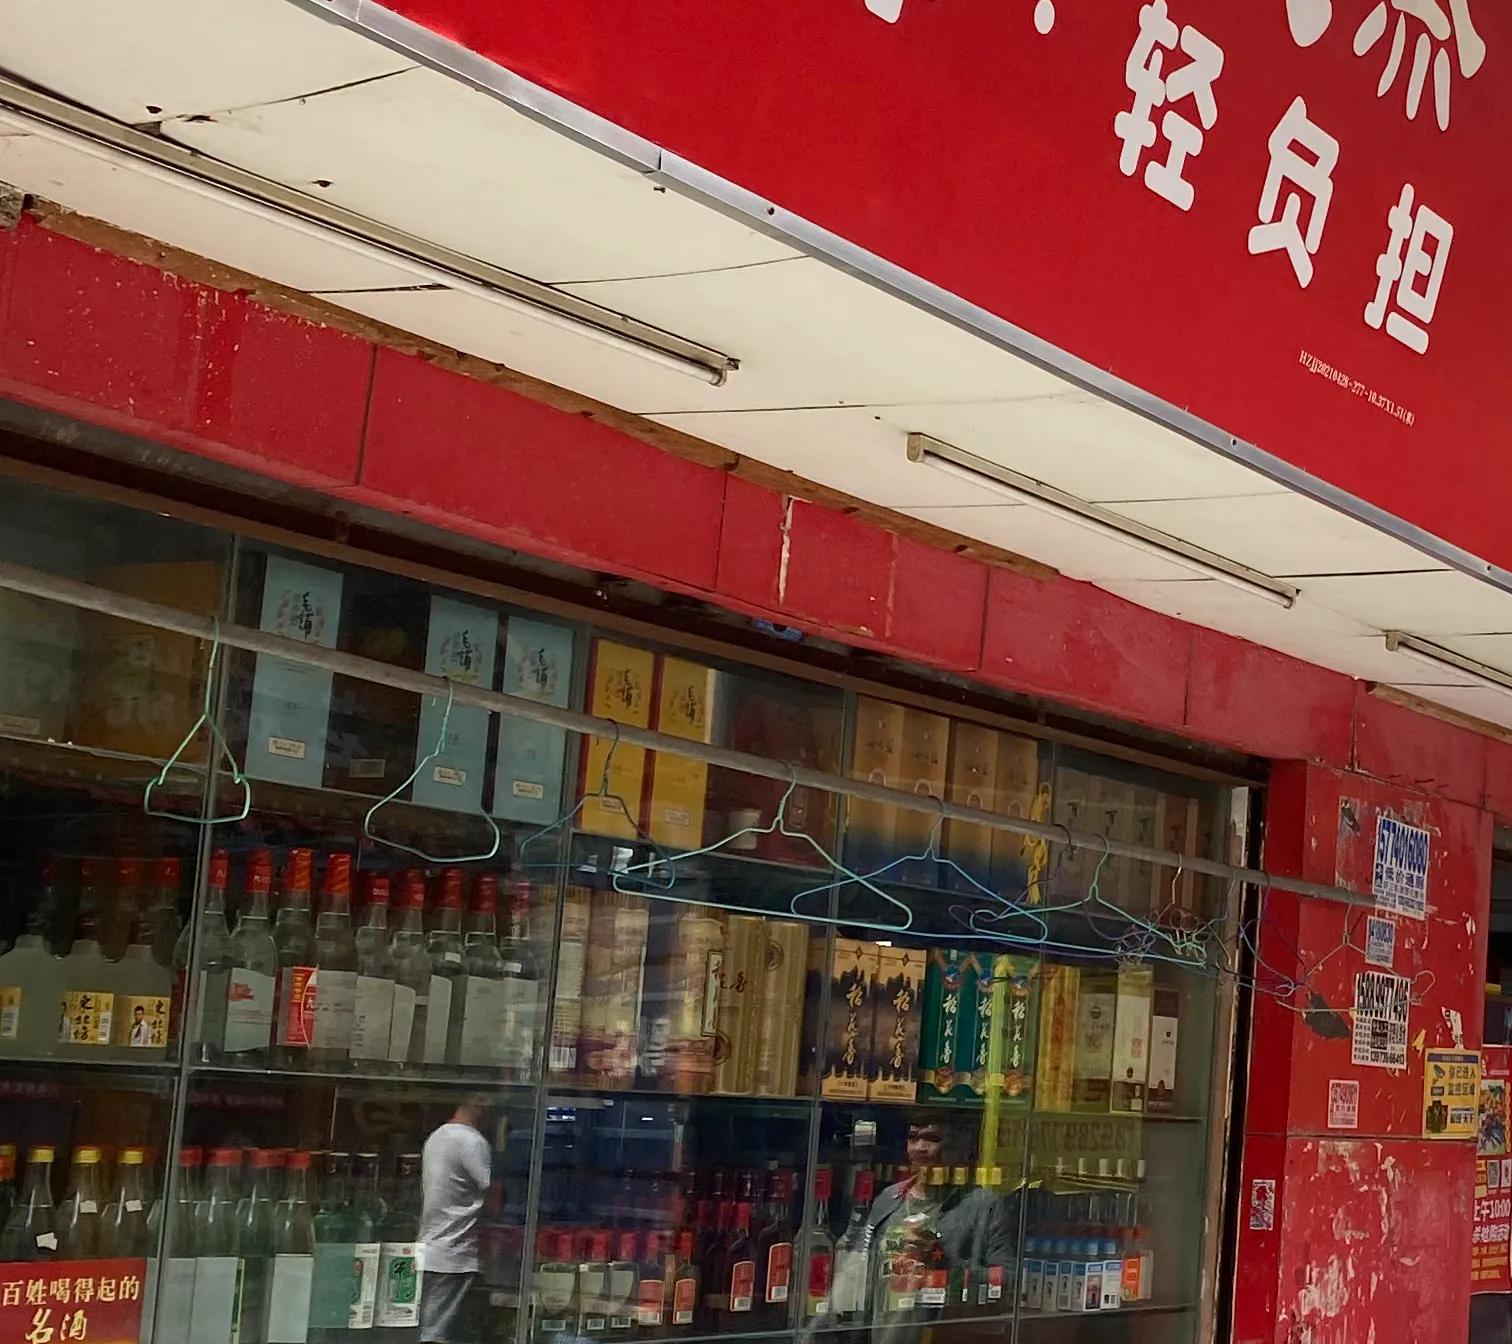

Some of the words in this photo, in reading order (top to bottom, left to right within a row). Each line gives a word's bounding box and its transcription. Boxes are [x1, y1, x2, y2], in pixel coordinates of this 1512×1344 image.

[1, 1275, 141, 1307] 百姓喝得起的
